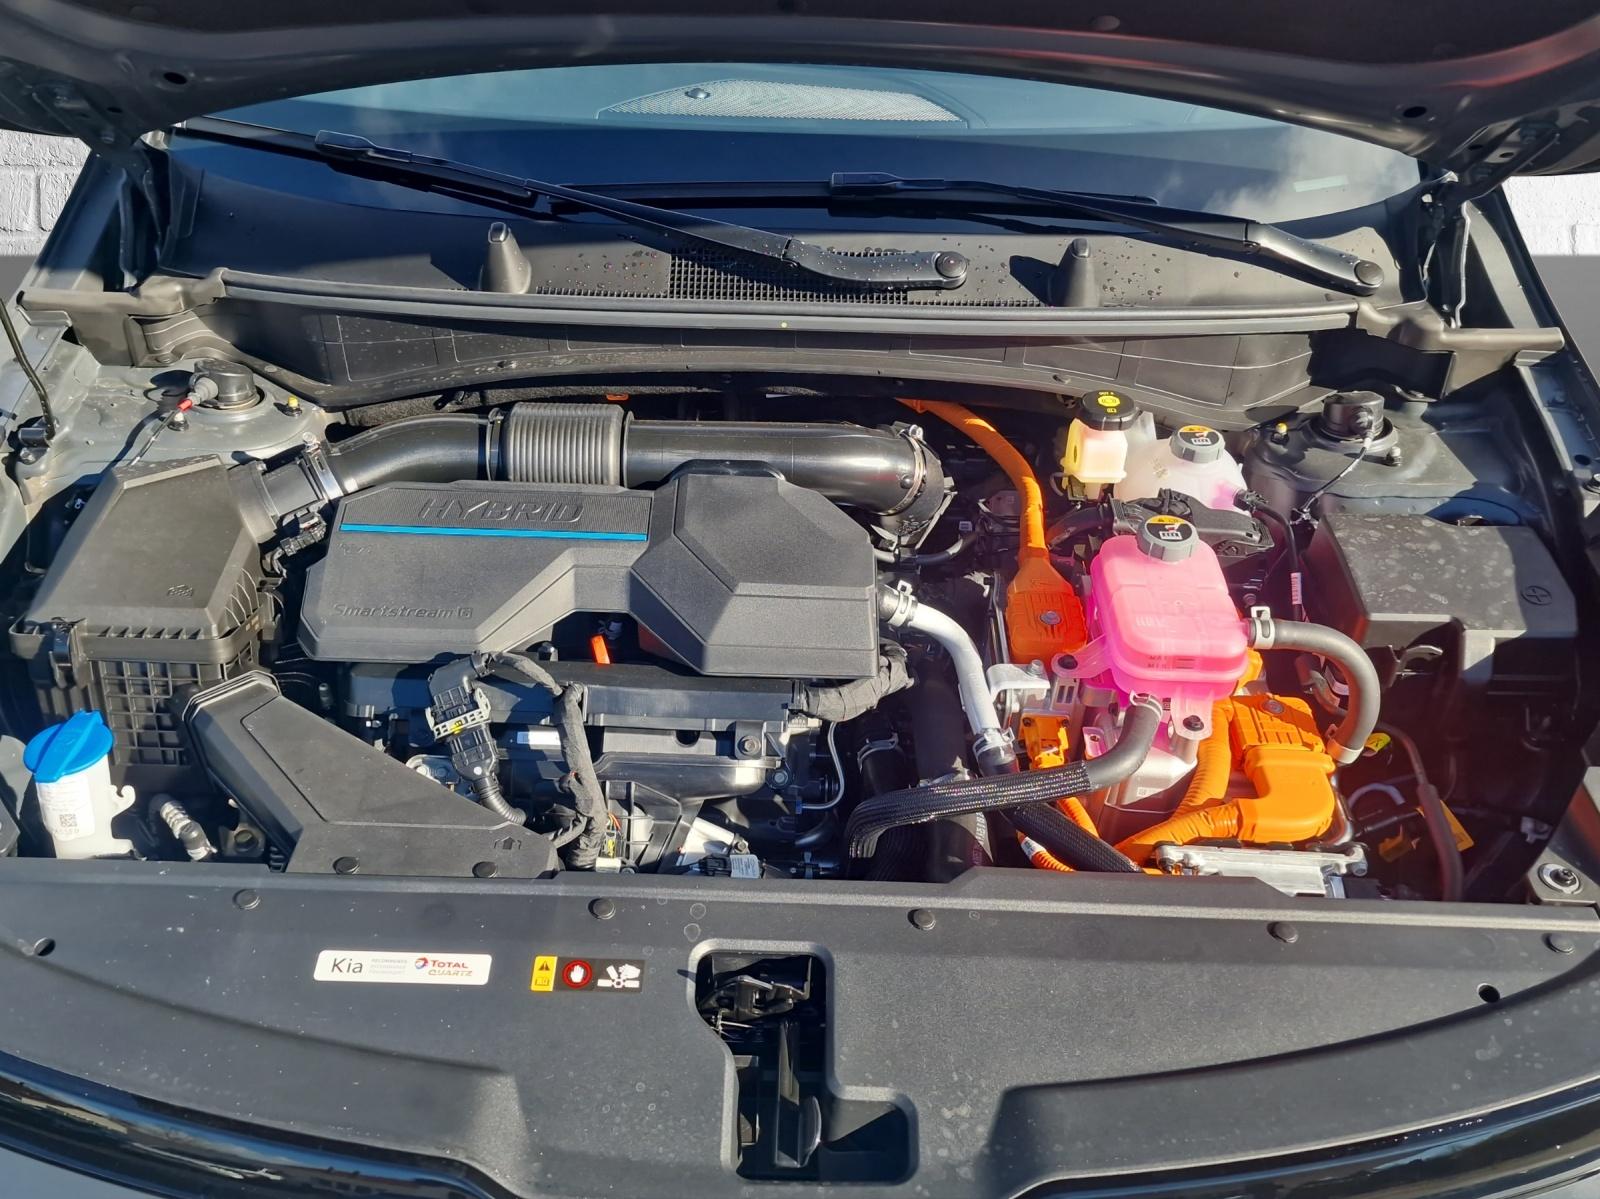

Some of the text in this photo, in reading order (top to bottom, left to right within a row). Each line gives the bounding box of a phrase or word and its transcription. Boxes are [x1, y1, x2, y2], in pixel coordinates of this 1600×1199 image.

[418, 499, 584, 523] HYBRID
[333, 603, 453, 618] Smartstream
[331, 958, 363, 974] Kia
[430, 959, 469, 969] TOTAL
